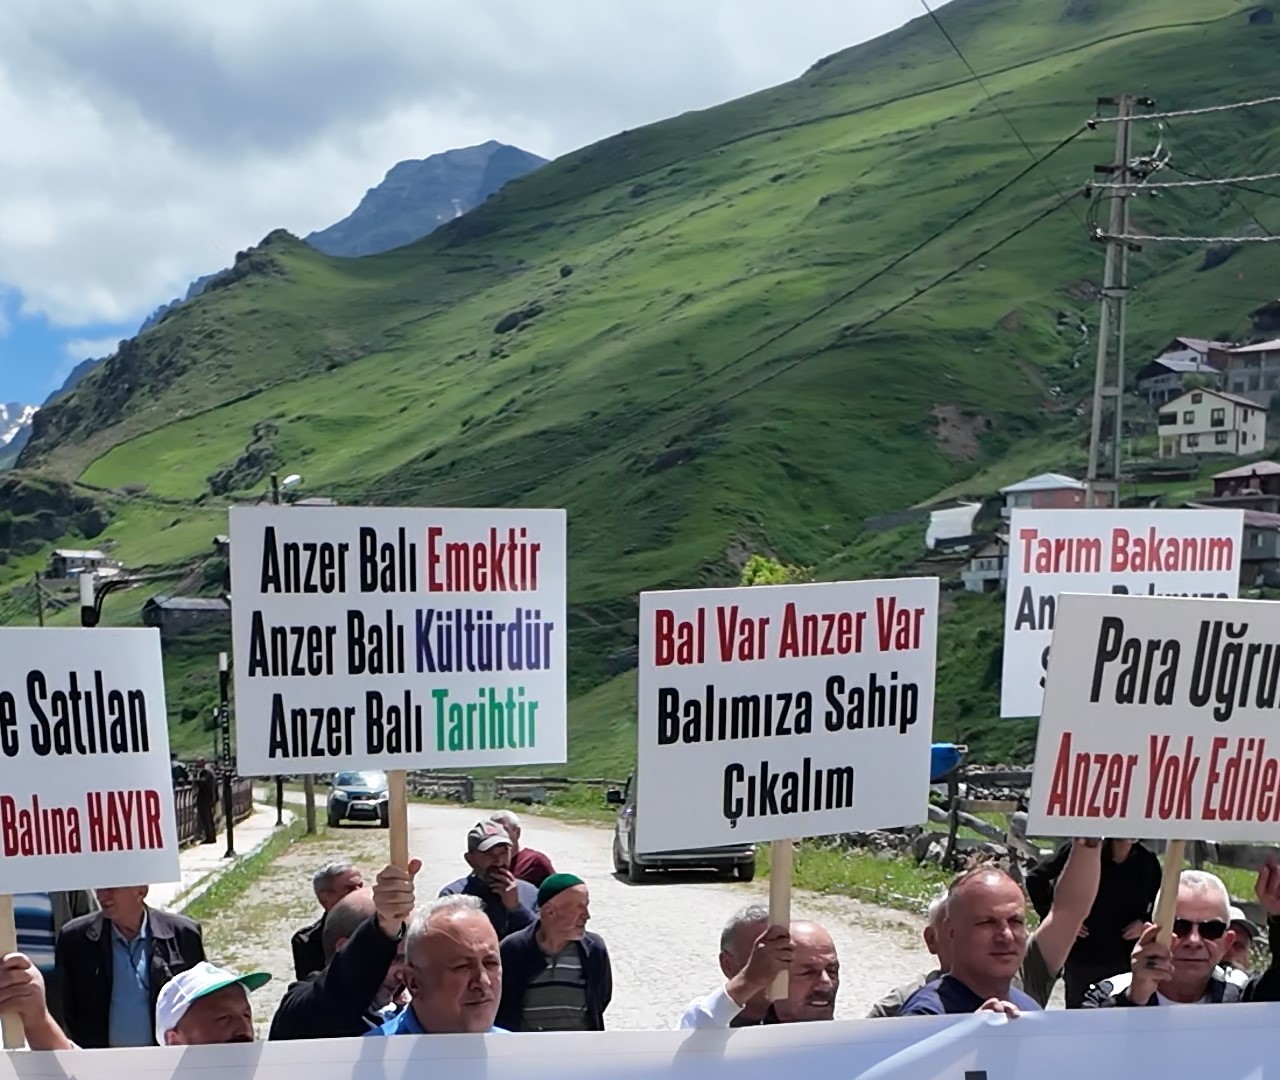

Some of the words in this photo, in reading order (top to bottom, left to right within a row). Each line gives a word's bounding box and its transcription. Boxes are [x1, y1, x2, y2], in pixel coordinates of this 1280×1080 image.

[260, 525, 350, 594] Anzer
[359, 526, 417, 594] Balı
[427, 526, 541, 593] Emektir
[1019, 528, 1102, 574] Tarım
[1110, 526, 1234, 573] Bakanım
[248, 610, 337, 678] Anzer
[346, 609, 405, 675] Balı
[415, 607, 554, 674] Kültürdür
[655, 607, 706, 667] Bal
[716, 605, 770, 663] Var
[778, 602, 867, 659] Anzer
[876, 596, 925, 652] Var
[1089, 616, 1181, 706] Para
[26, 669, 150, 757] Satılan
[268, 693, 356, 759] Anzer
[365, 689, 423, 755] Balı
[431, 686, 539, 753] Tarihtir
[657, 684, 813, 746] Balımıza
[824, 670, 919, 735] Sahip
[723, 757, 854, 829] Çıkalım
[1046, 731, 1139, 819] Anzer
[1144, 734, 1201, 821] Yok
[0, 794, 82, 857] Balına
[86, 789, 164, 853] HAYIR
